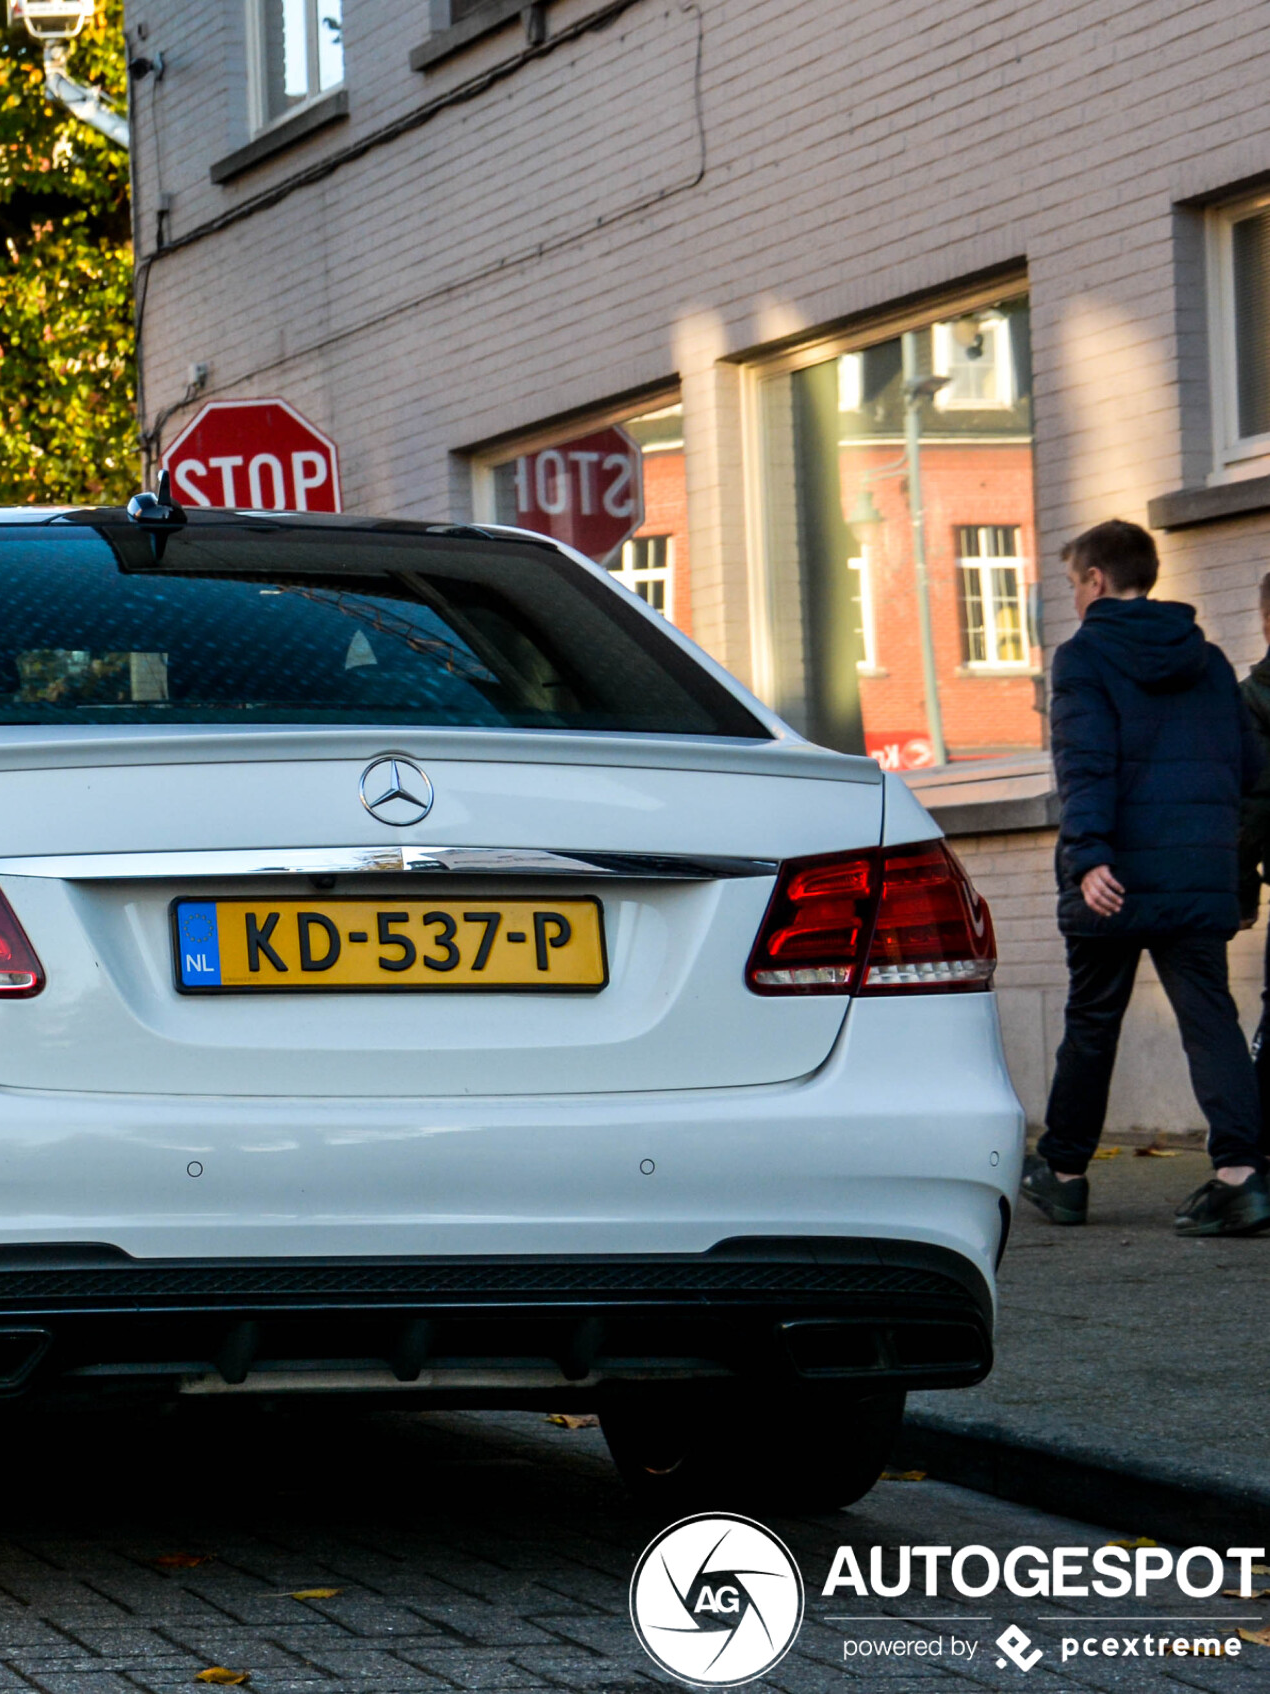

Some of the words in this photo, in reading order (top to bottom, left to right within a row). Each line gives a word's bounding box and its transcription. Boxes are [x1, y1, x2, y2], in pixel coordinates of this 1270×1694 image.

[175, 451, 328, 511] STOP
[186, 954, 215, 972] NL
[244, 912, 572, 973] KD-537-P
